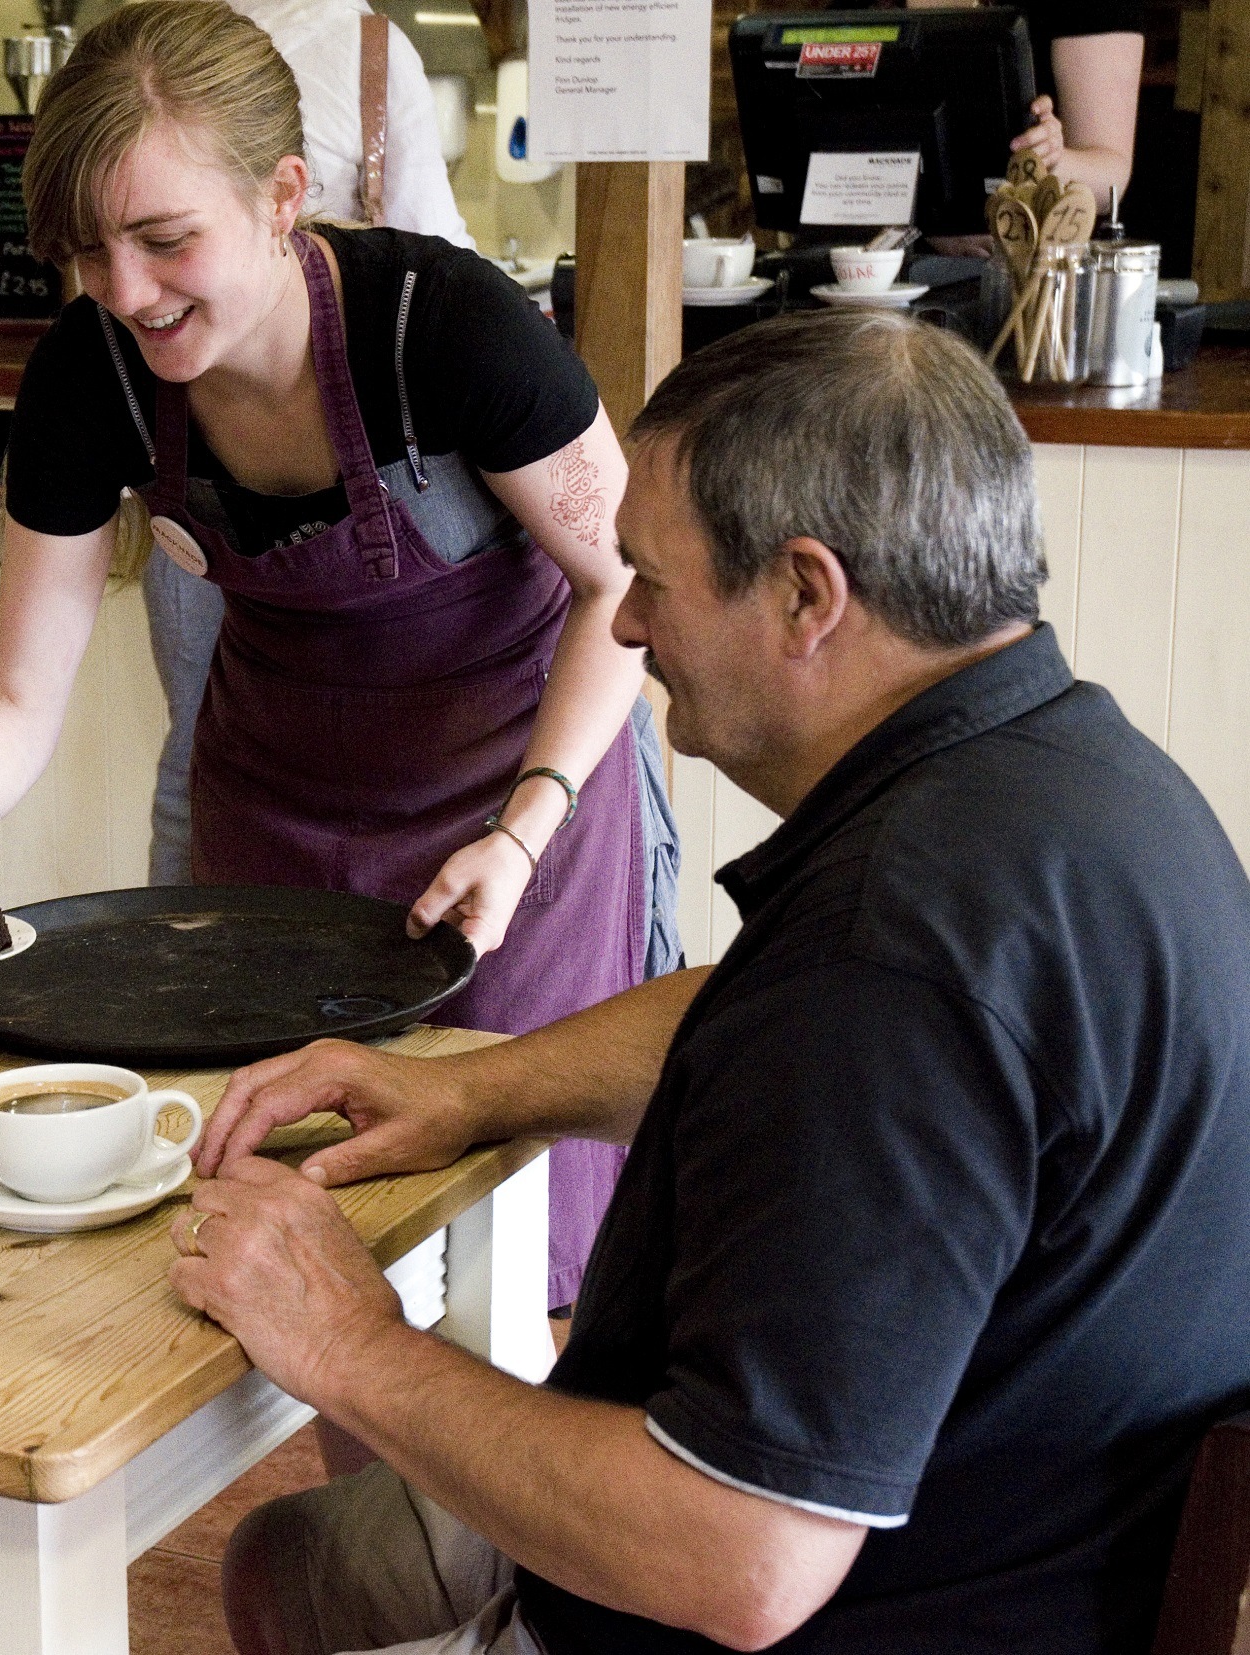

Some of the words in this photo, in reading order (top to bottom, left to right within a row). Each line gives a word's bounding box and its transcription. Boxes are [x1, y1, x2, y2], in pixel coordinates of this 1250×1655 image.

[622, 4, 648, 13] energy
[649, 2, 678, 10] efficient
[606, 36, 622, 44] your
[804, 46, 852, 59] UNDER
[555, 86, 583, 94] General
[585, 85, 617, 95] Manager
